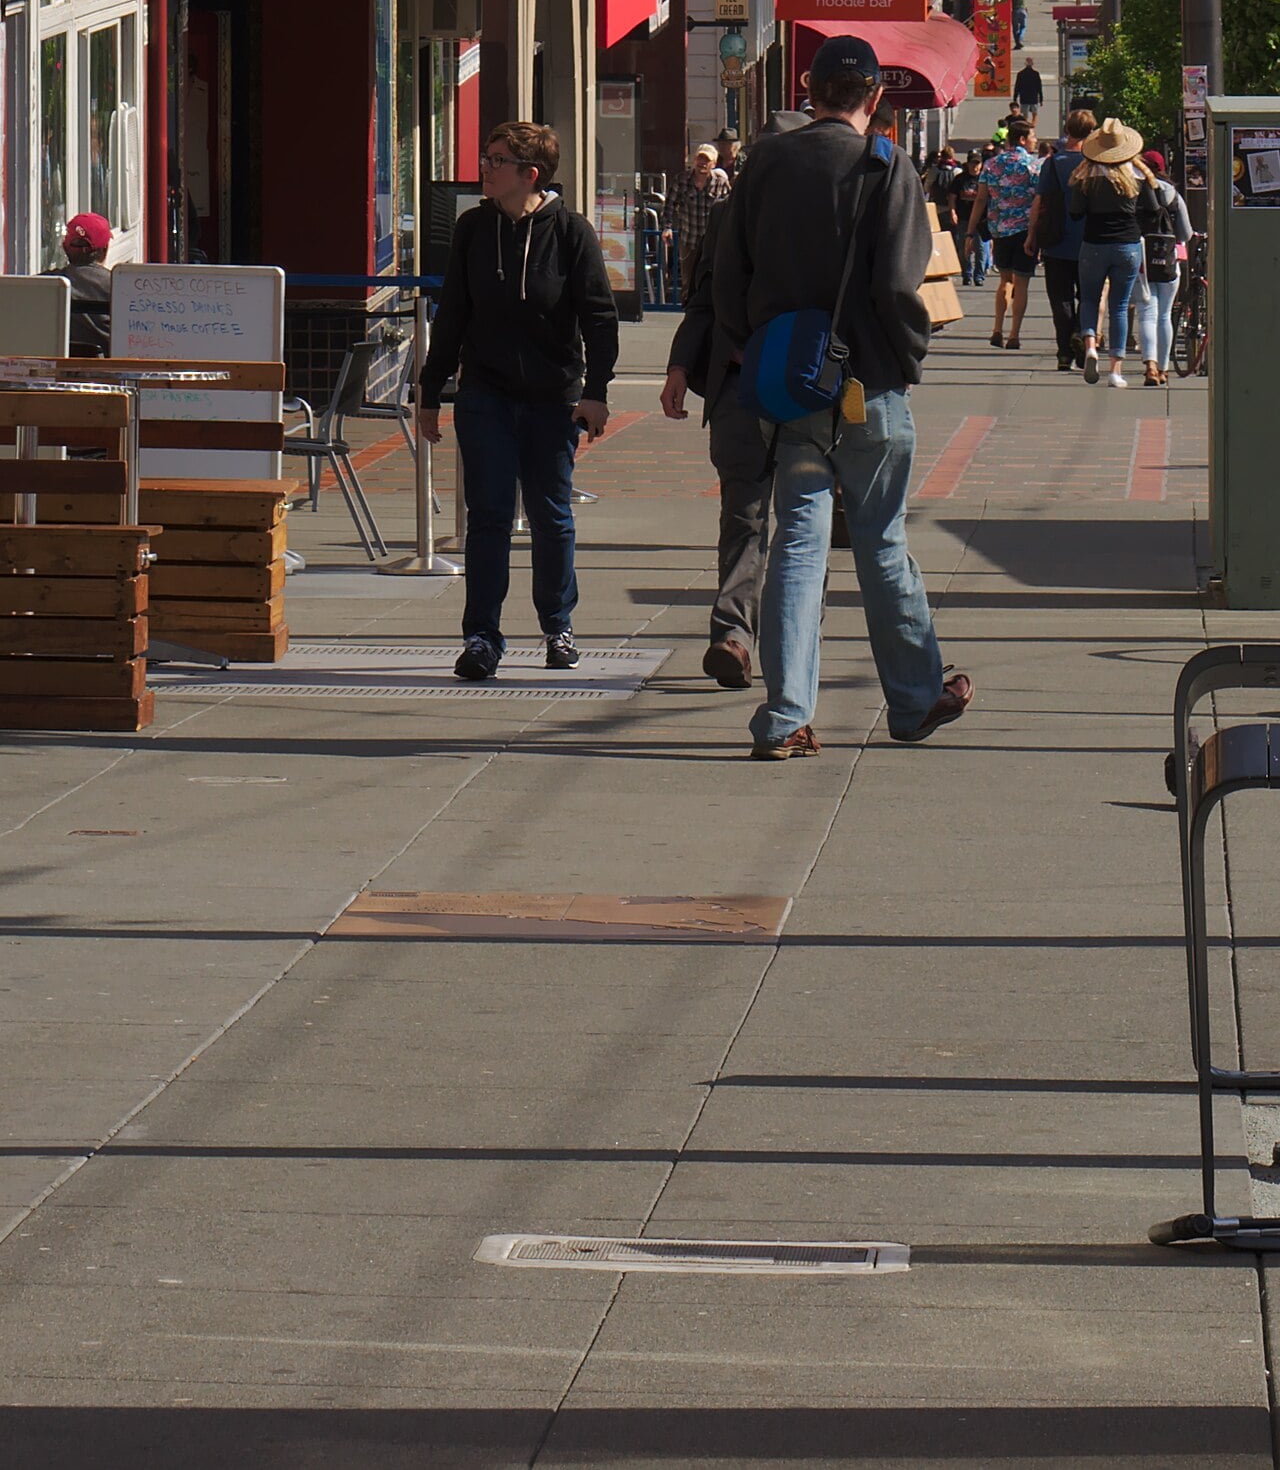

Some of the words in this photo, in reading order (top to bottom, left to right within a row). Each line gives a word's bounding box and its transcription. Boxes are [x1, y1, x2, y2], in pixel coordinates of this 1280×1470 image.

[720, 4, 745, 16] CREAM
[134, 278, 184, 292] CASTRO
[189, 278, 248, 295] COFFEE
[128, 300, 186, 314] ESPRESSO
[160, 322, 189, 334] MADE
[192, 322, 244, 336] COFFEE
